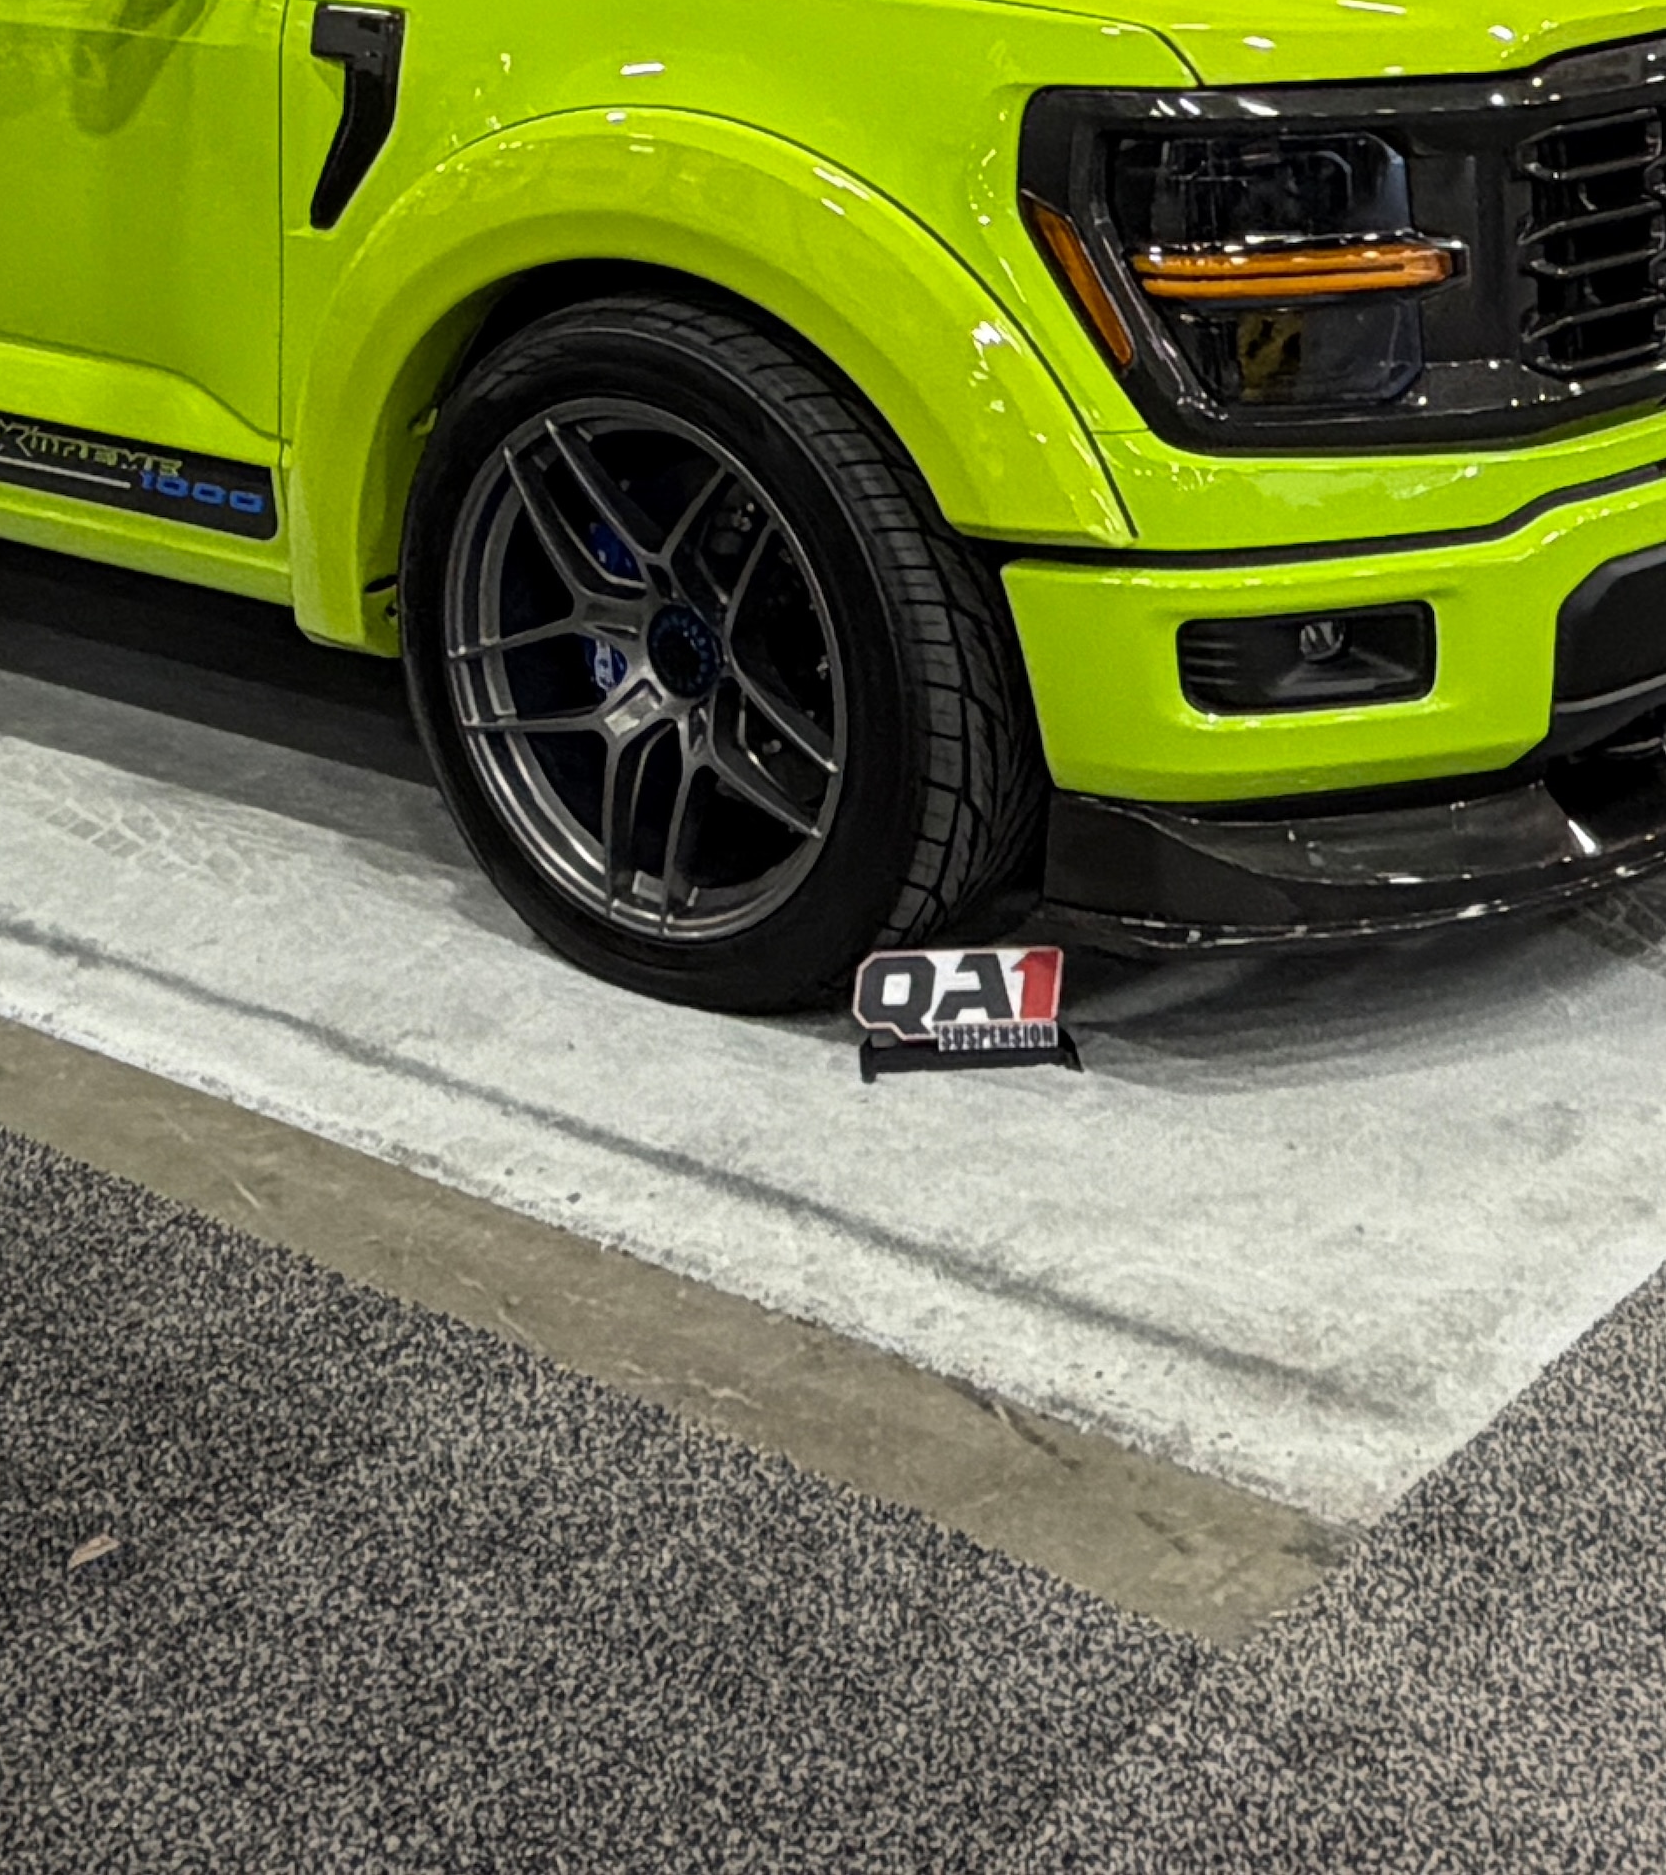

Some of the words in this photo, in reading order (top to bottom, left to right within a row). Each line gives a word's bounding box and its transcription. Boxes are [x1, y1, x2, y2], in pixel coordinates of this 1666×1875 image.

[140, 470, 265, 515] 1000
[858, 949, 1059, 1036] QA1
[940, 1024, 1055, 1051] SUSPENSION
